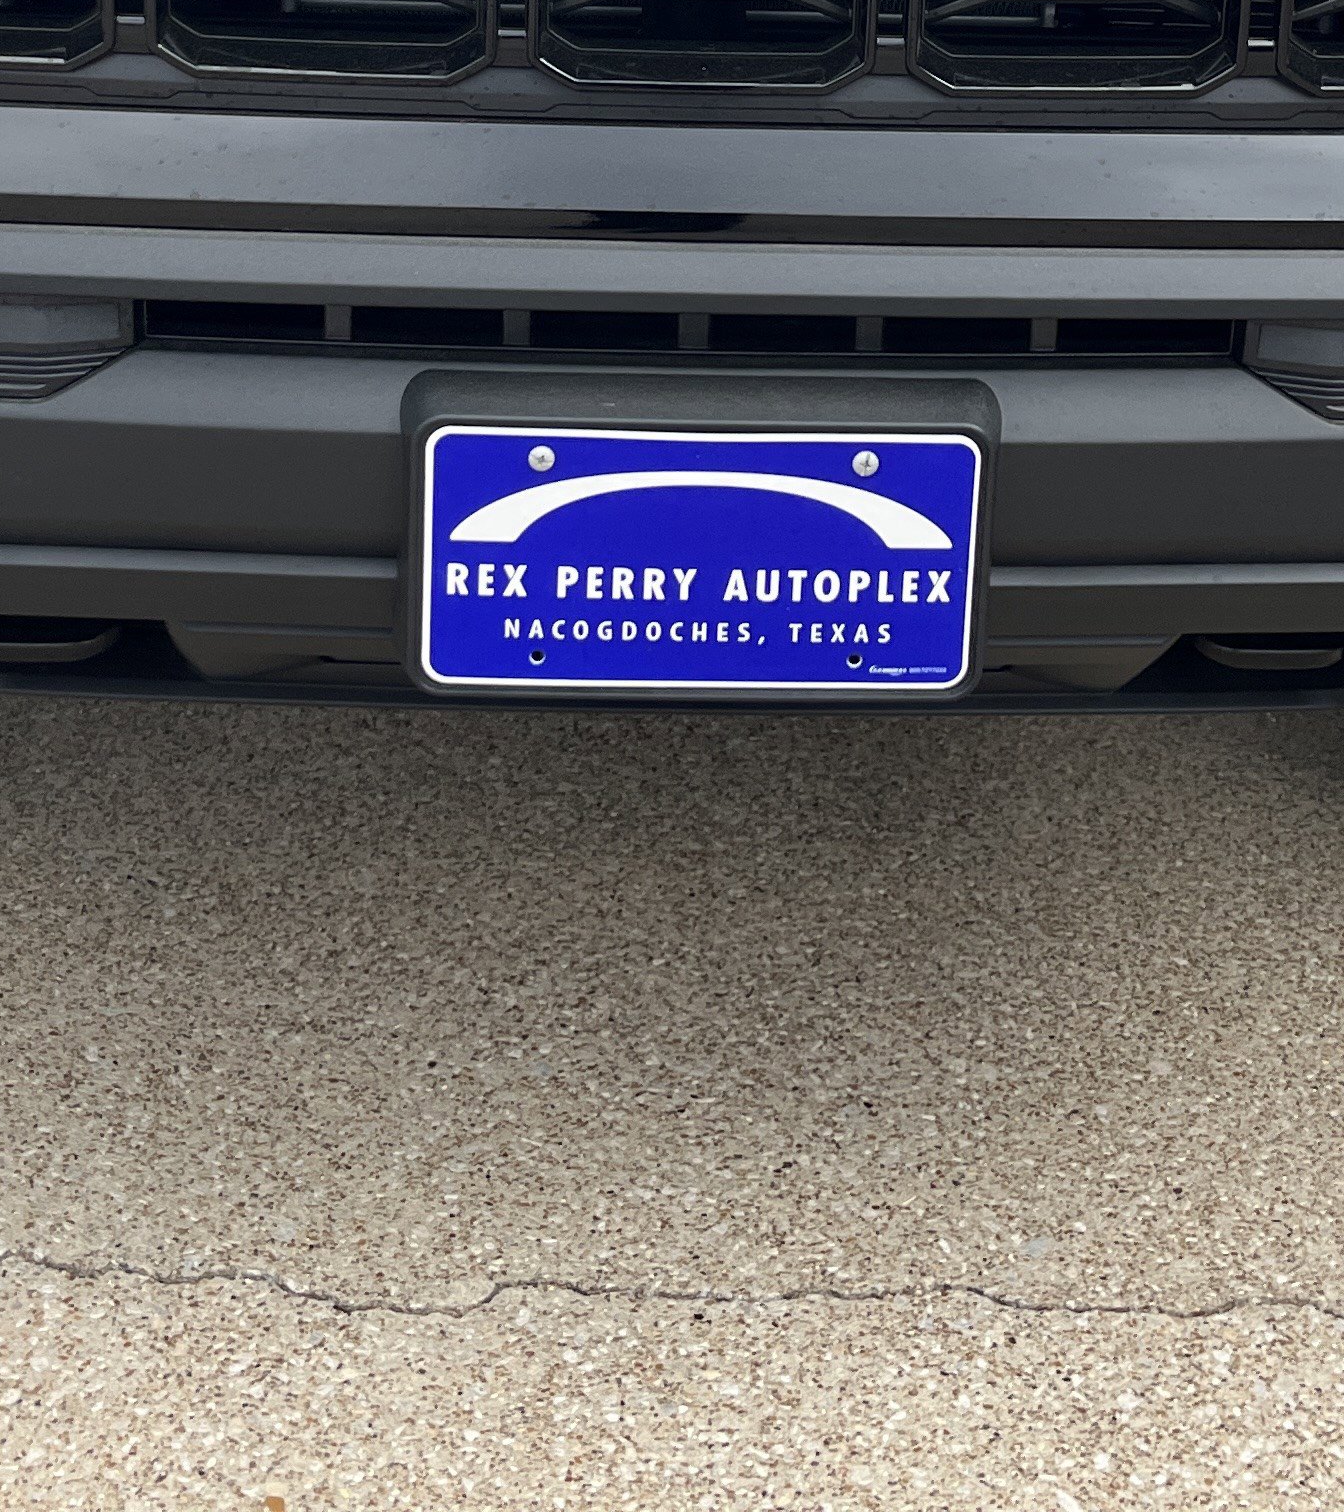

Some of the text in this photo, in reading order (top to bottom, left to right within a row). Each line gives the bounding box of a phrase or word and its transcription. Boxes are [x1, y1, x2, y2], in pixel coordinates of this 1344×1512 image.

[445, 561, 953, 604] REX PERRY AUTOPLEX
[503, 618, 892, 646] NACOGDOCHES, TEXAS
